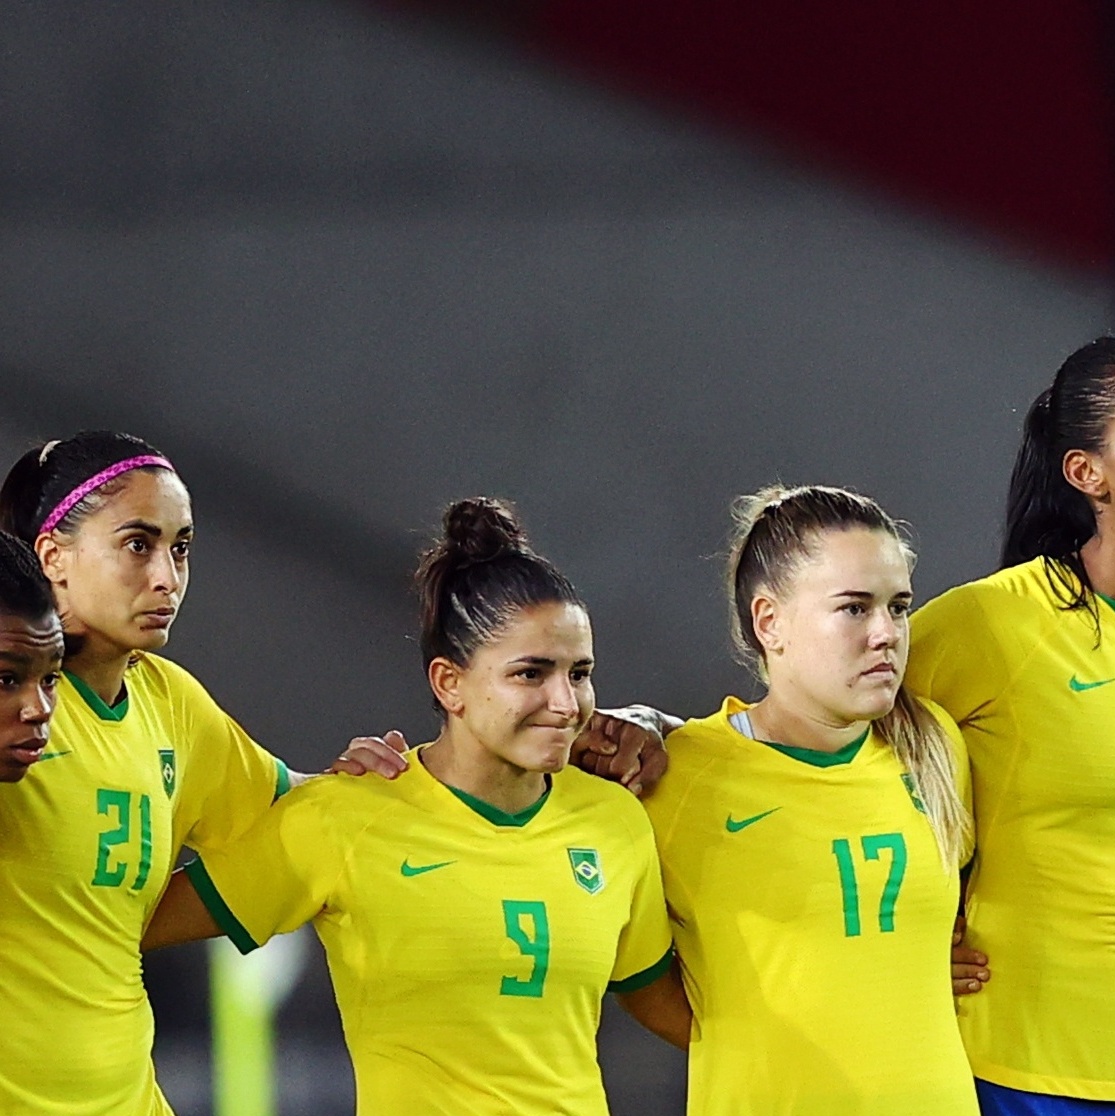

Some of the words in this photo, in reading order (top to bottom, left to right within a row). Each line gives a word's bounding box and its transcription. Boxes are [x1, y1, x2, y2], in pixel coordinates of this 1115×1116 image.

[92, 788, 153, 894] 21
[832, 832, 908, 937] 17
[500, 899, 551, 998] 9
